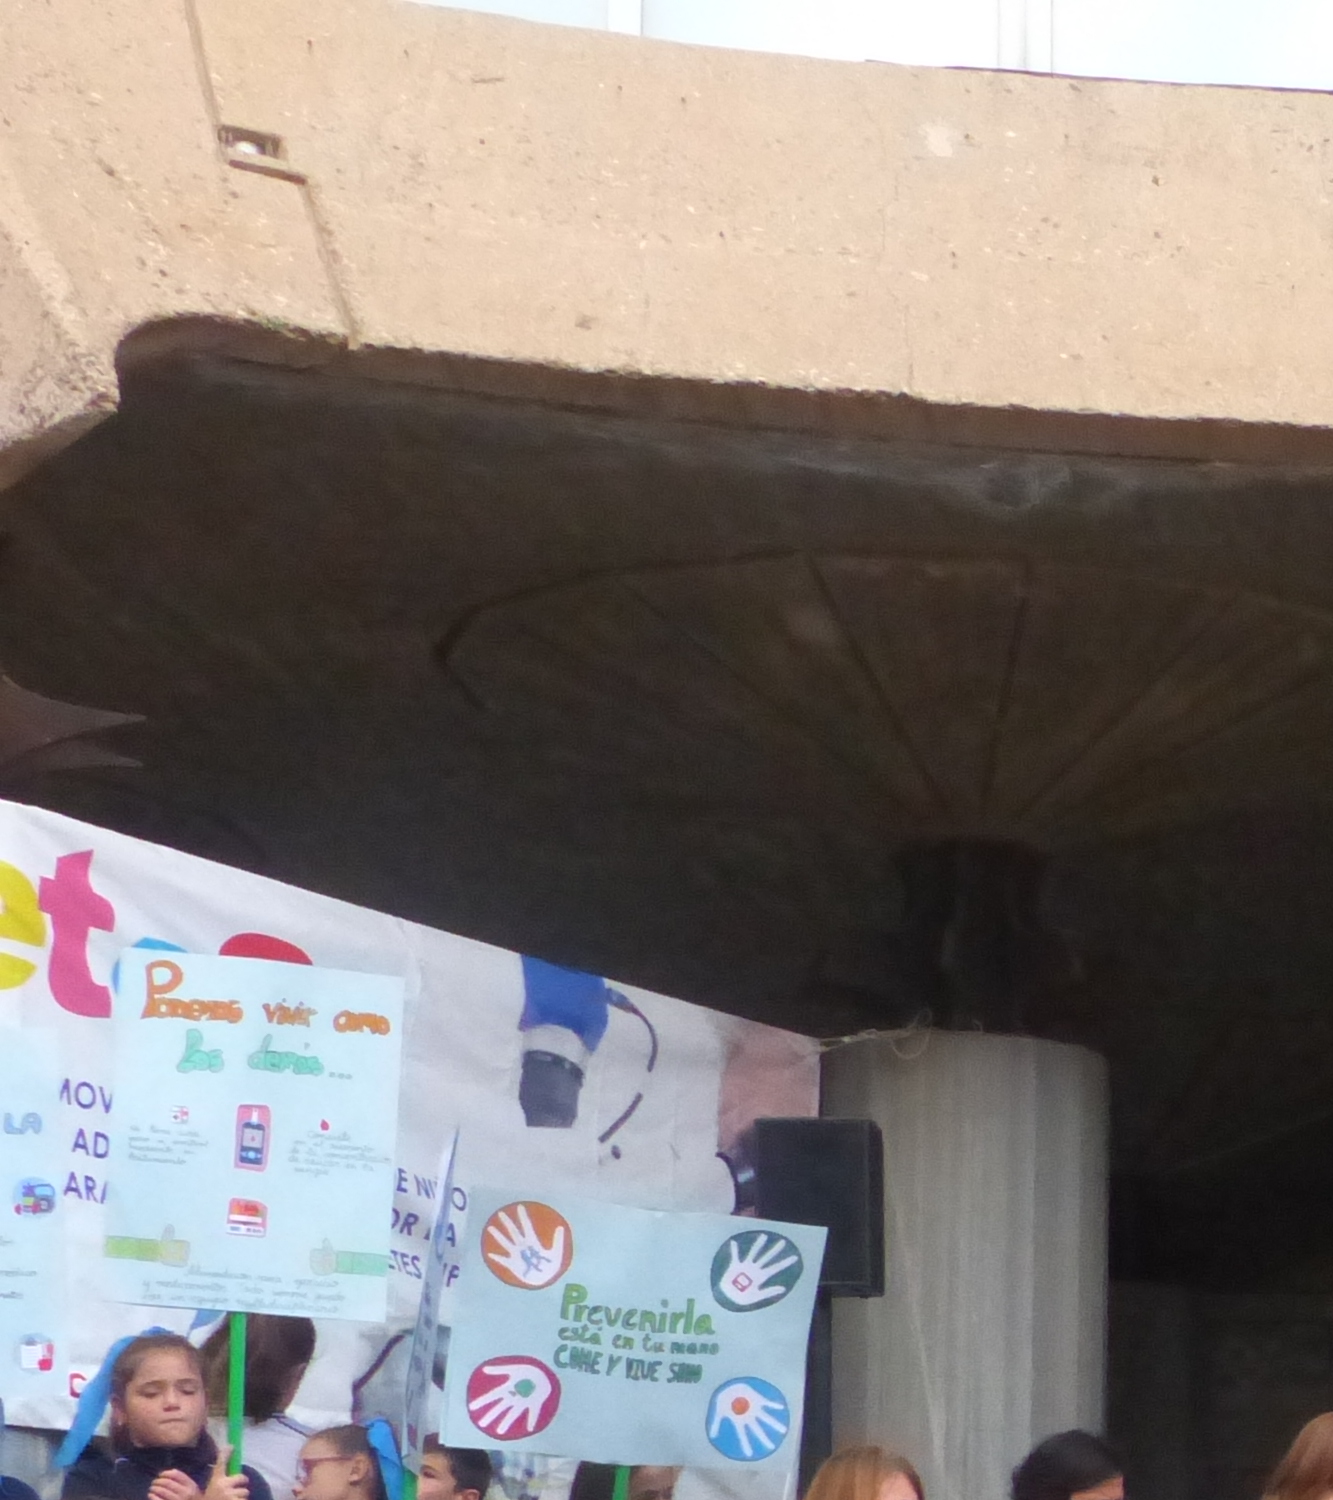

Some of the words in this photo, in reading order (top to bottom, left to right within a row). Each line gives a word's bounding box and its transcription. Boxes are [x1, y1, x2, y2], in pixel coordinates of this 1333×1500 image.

[560, 1283, 715, 1335] Prevenirla
[612, 1334, 635, 1350] en
[642, 1333, 665, 1352] tu
[670, 1342, 720, 1355] mano
[606, 1354, 622, 1376] Y
